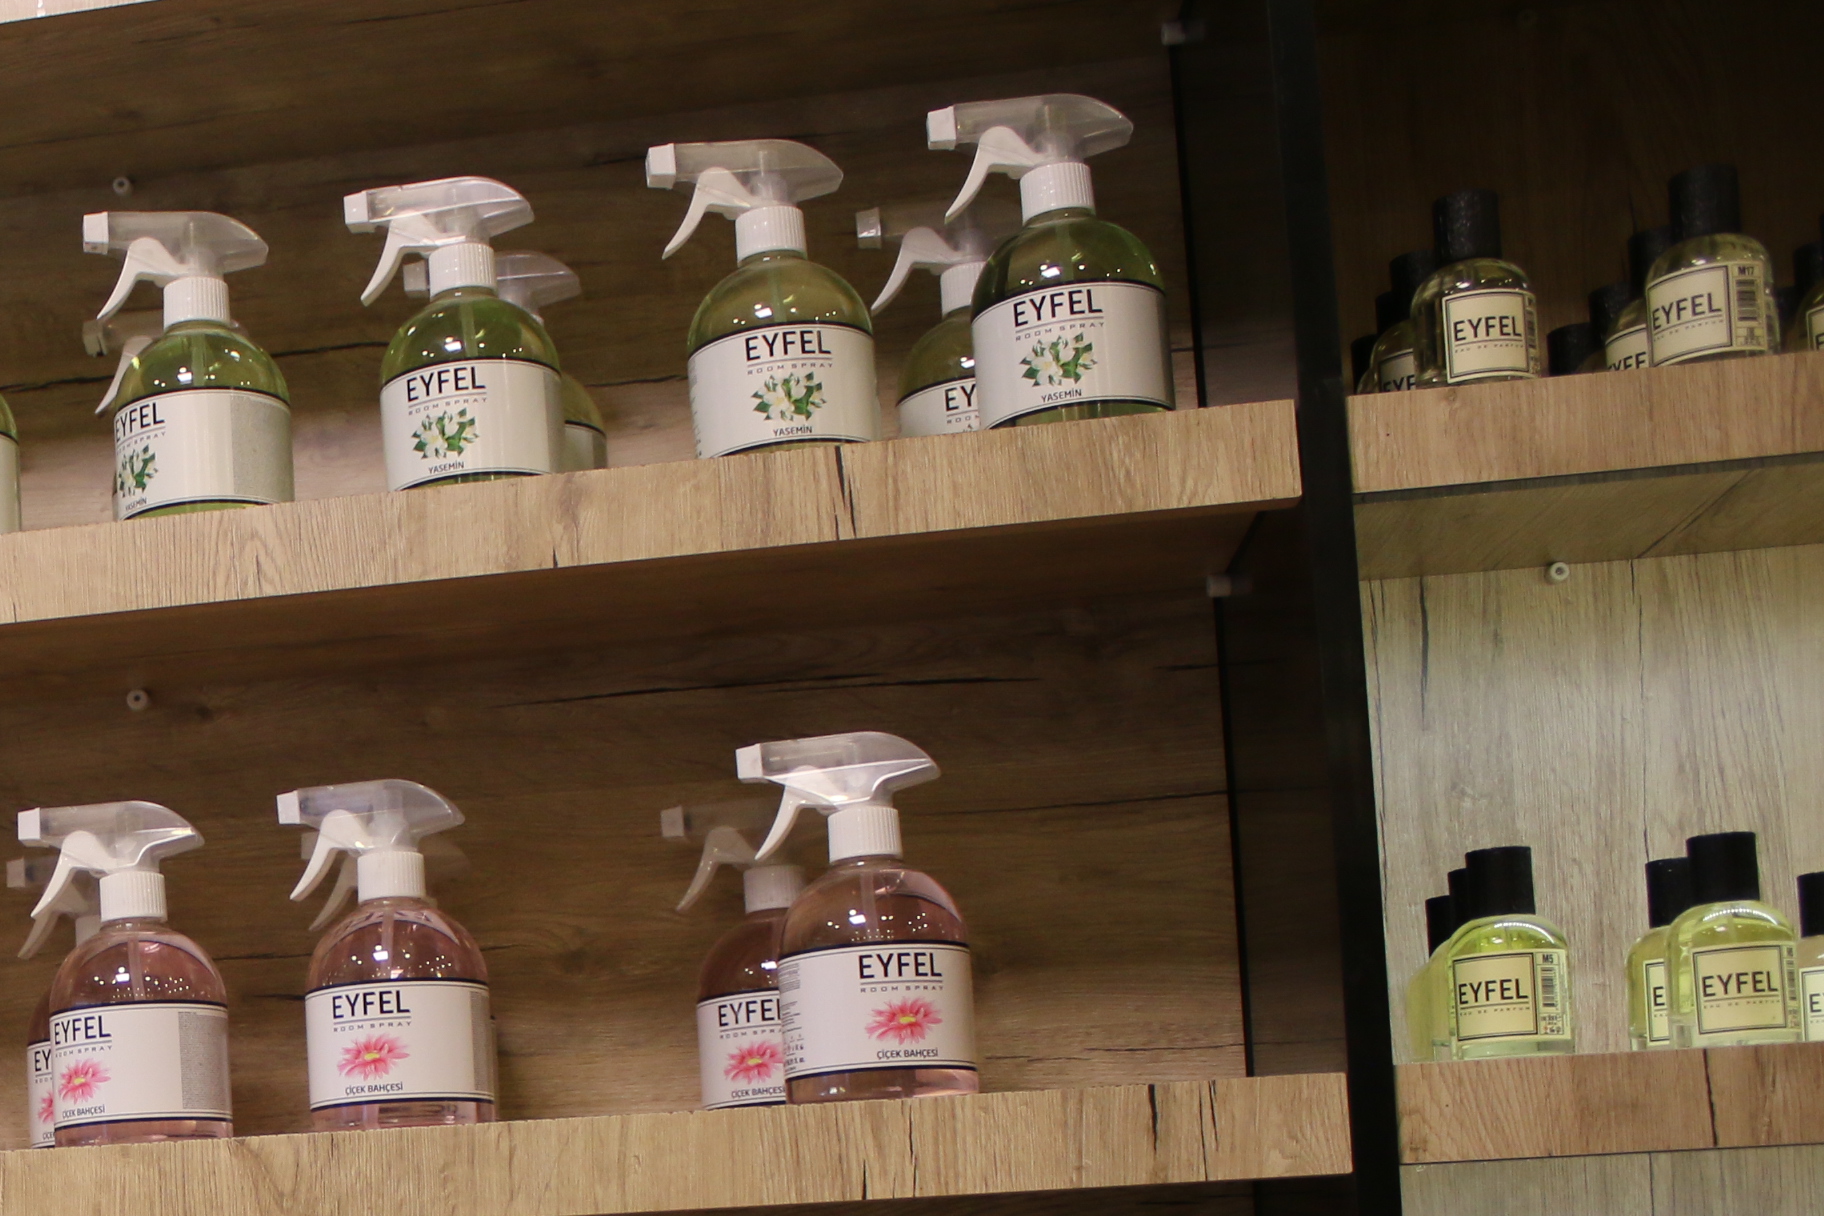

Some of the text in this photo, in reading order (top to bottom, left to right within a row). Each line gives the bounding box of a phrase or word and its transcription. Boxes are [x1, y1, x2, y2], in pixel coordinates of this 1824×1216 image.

[1013, 289, 1103, 328] EYFEL
[1652, 292, 1722, 331] EYFEL
[1015, 321, 1105, 341] ROOM SPRAY
[1453, 315, 1522, 342] EYFEL
[745, 330, 832, 362] EYFEL
[747, 362, 833, 376] ROOM SPRAY
[407, 366, 485, 403] EYFEL
[1041, 389, 1082, 404] YASEMİN
[773, 424, 813, 437] YASEMİN
[428, 461, 465, 474] YASEMİN
[858, 952, 943, 979] EYFEL
[860, 985, 899, 993] ROOM
[1458, 978, 1529, 1005] EYFEL
[1702, 970, 1779, 998] EYFEL
[332, 990, 410, 1019] EYFEL
[55, 1015, 112, 1045] EYFEL
[876, 1048, 938, 1060] ÇİÇEK BAHÇESİ
